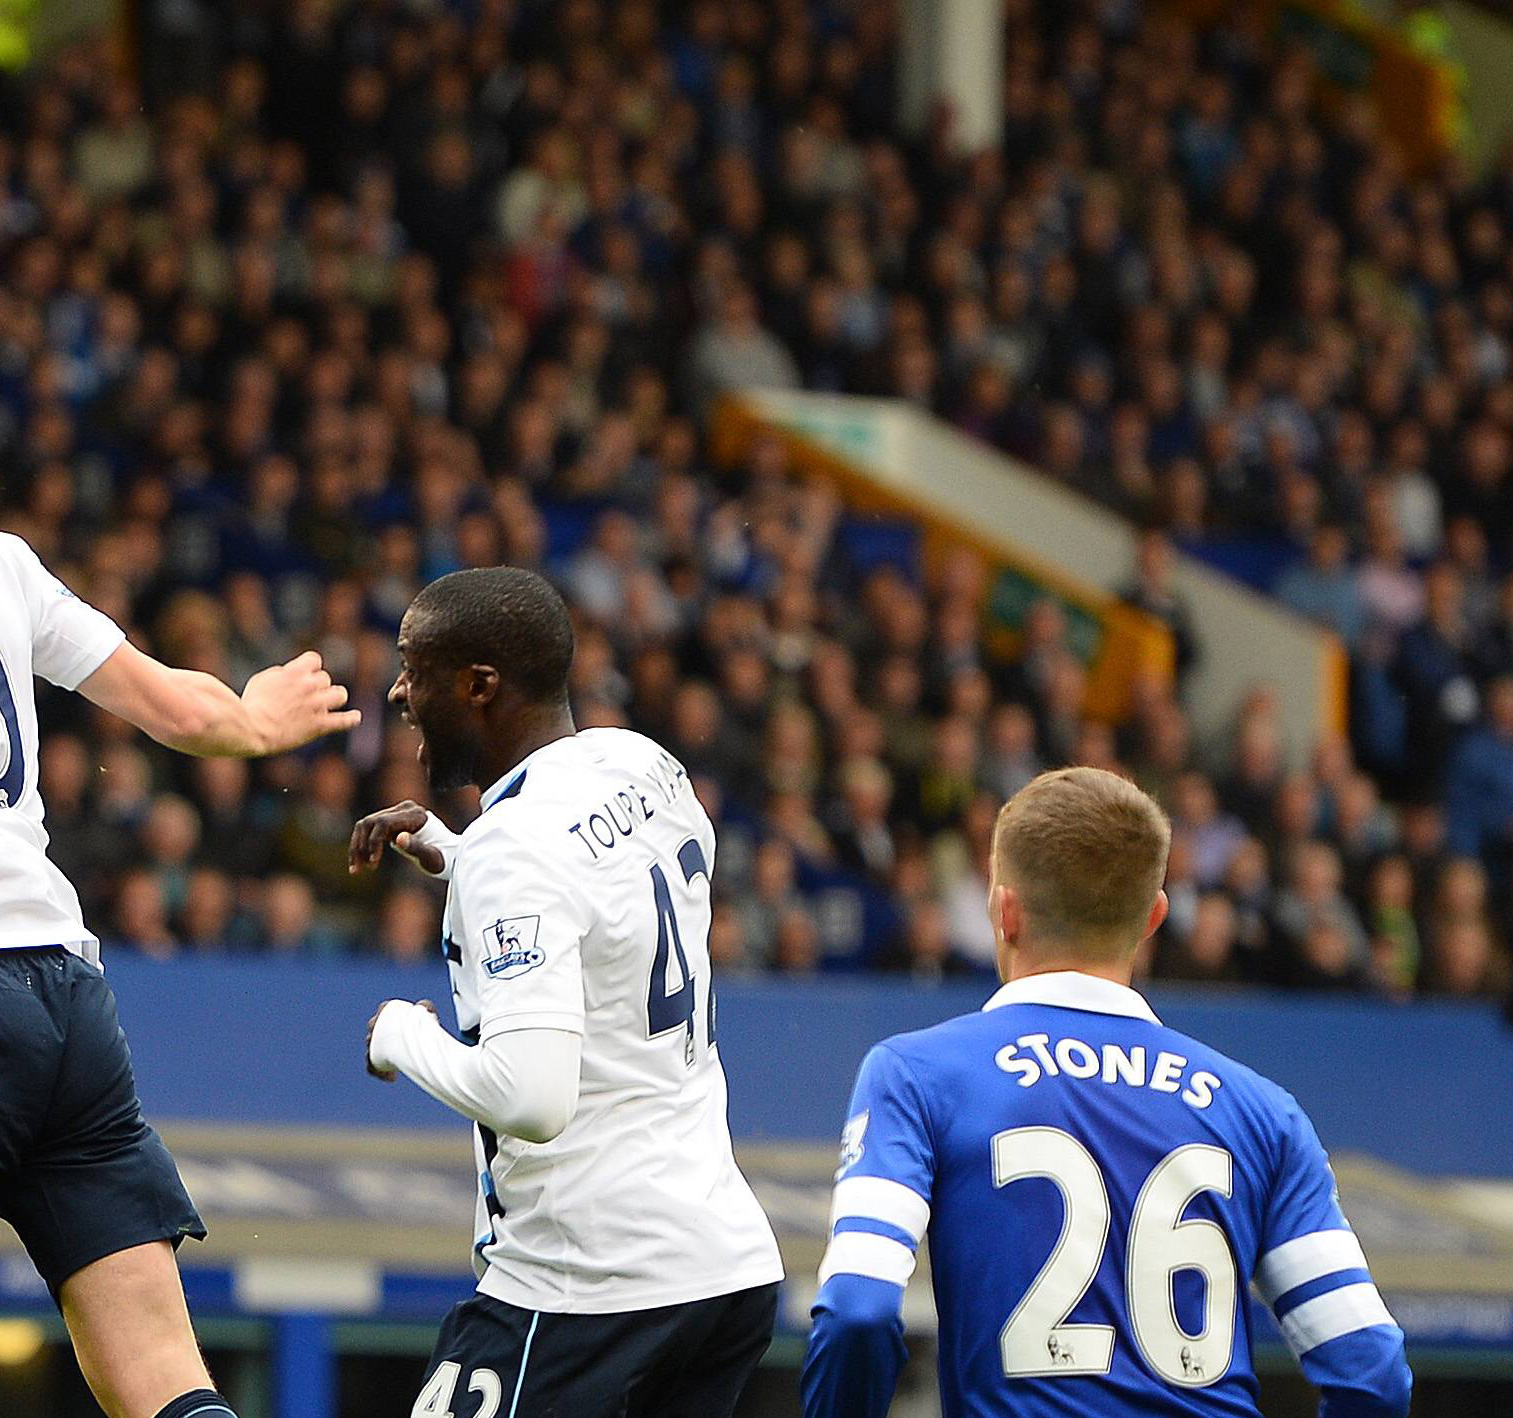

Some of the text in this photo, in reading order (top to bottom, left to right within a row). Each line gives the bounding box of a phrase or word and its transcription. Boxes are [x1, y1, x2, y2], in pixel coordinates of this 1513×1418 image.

[993, 1033, 1222, 1110] STONES
[990, 1125, 1238, 1389] 26
[410, 1360, 502, 1418] 42
